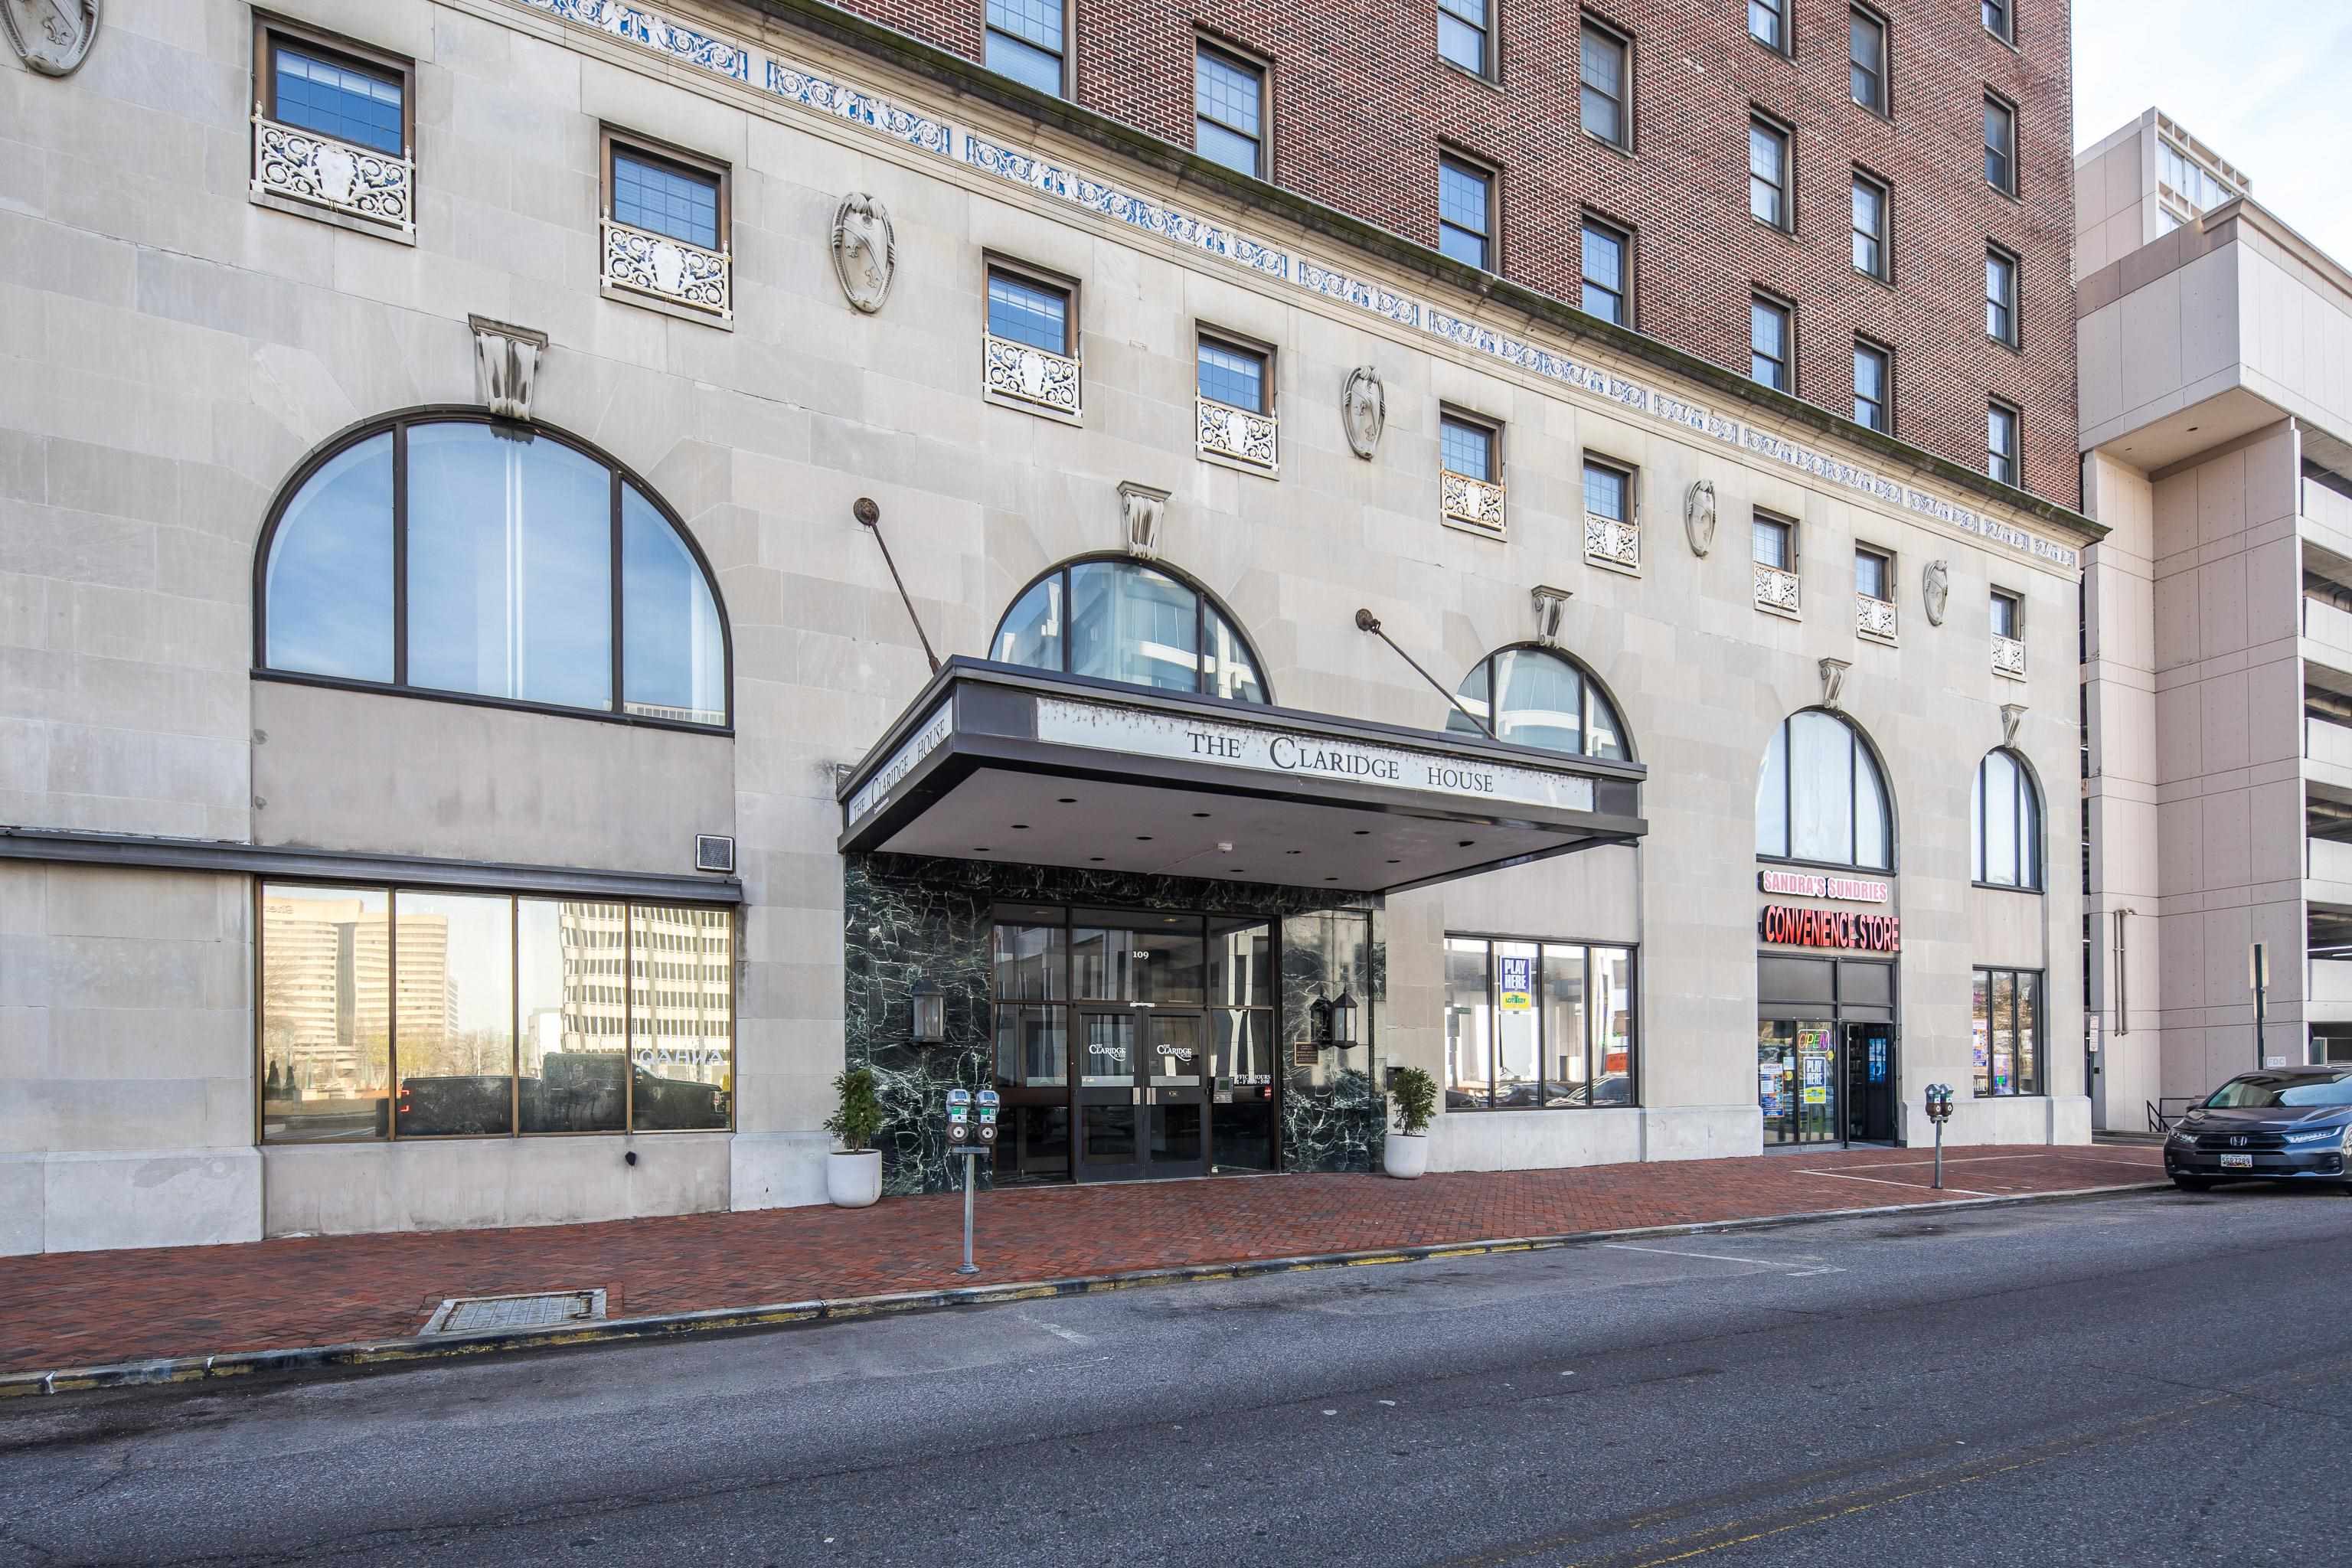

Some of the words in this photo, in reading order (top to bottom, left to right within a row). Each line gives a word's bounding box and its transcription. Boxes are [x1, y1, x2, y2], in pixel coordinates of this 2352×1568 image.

[1186, 732, 1241, 759] THE
[1269, 737, 1400, 780] CLARIDGE
[1427, 766, 1494, 793] HOUSE
[854, 799, 865, 821] THE
[872, 755, 907, 805] CLARIDGE
[917, 720, 945, 761] HOUSE
[1764, 872, 1825, 895] SANDRA'S
[1828, 880, 1887, 900] SUNDRIES
[1765, 905, 1857, 948] CONVENIENCE
[1860, 914, 1900, 951] STORE
[1132, 951, 1149, 960] 109
[1504, 959, 1526, 974] PLAY
[1504, 975, 1526, 989] HERE
[1798, 1034, 1828, 1049] OPEN
[639, 1048, 724, 1066] QAHWA
[1089, 1044, 1126, 1057] CLARIDGE
[1157, 1044, 1192, 1057] CLARIDGE
[1806, 1060, 1822, 1072] PLAY
[1806, 1072, 1822, 1085] HERE
